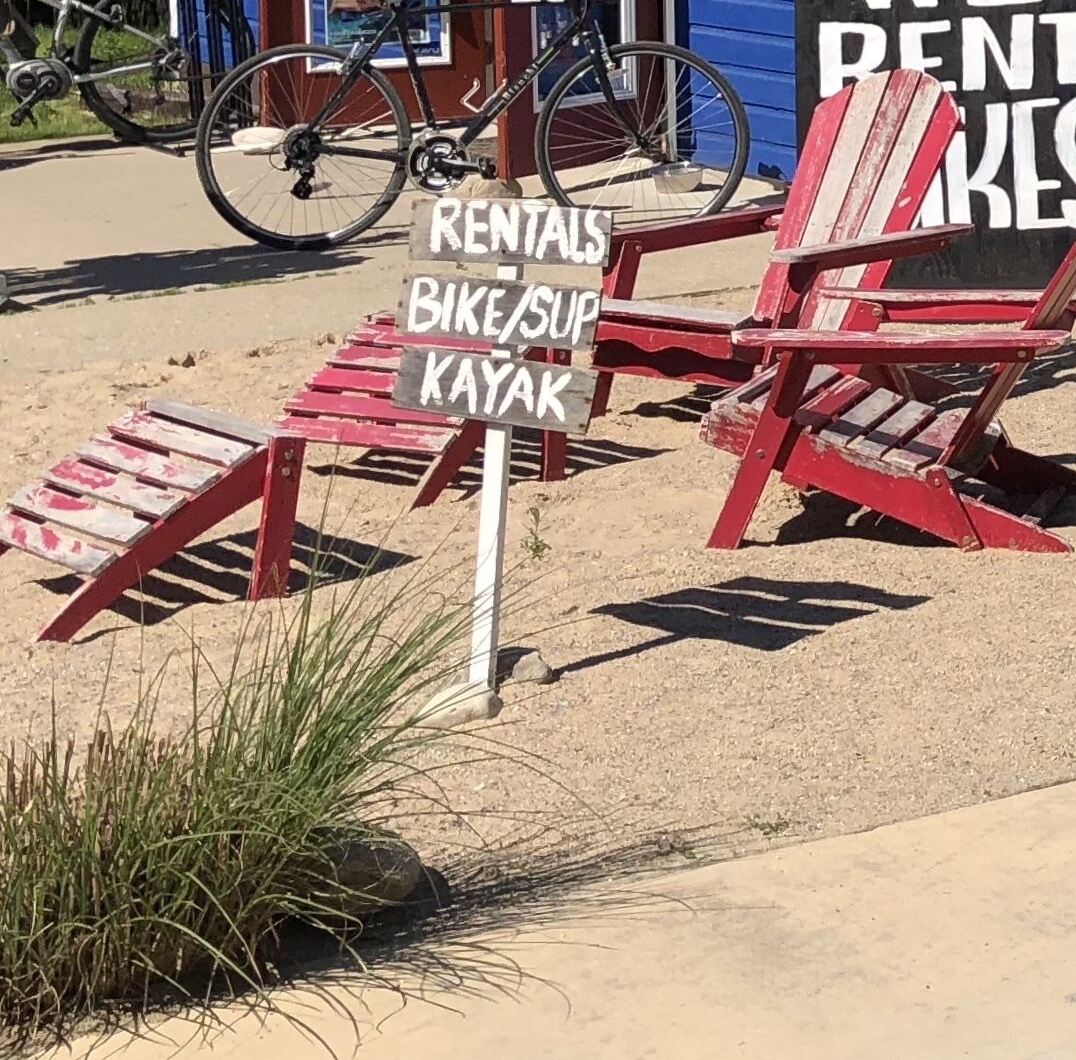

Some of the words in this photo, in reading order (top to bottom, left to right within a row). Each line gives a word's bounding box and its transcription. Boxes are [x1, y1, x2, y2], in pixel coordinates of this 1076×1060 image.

[430, 197, 613, 265] RENTALS
[407, 275, 601, 346] BIKE/SUP
[419, 350, 573, 423] KAYAK
